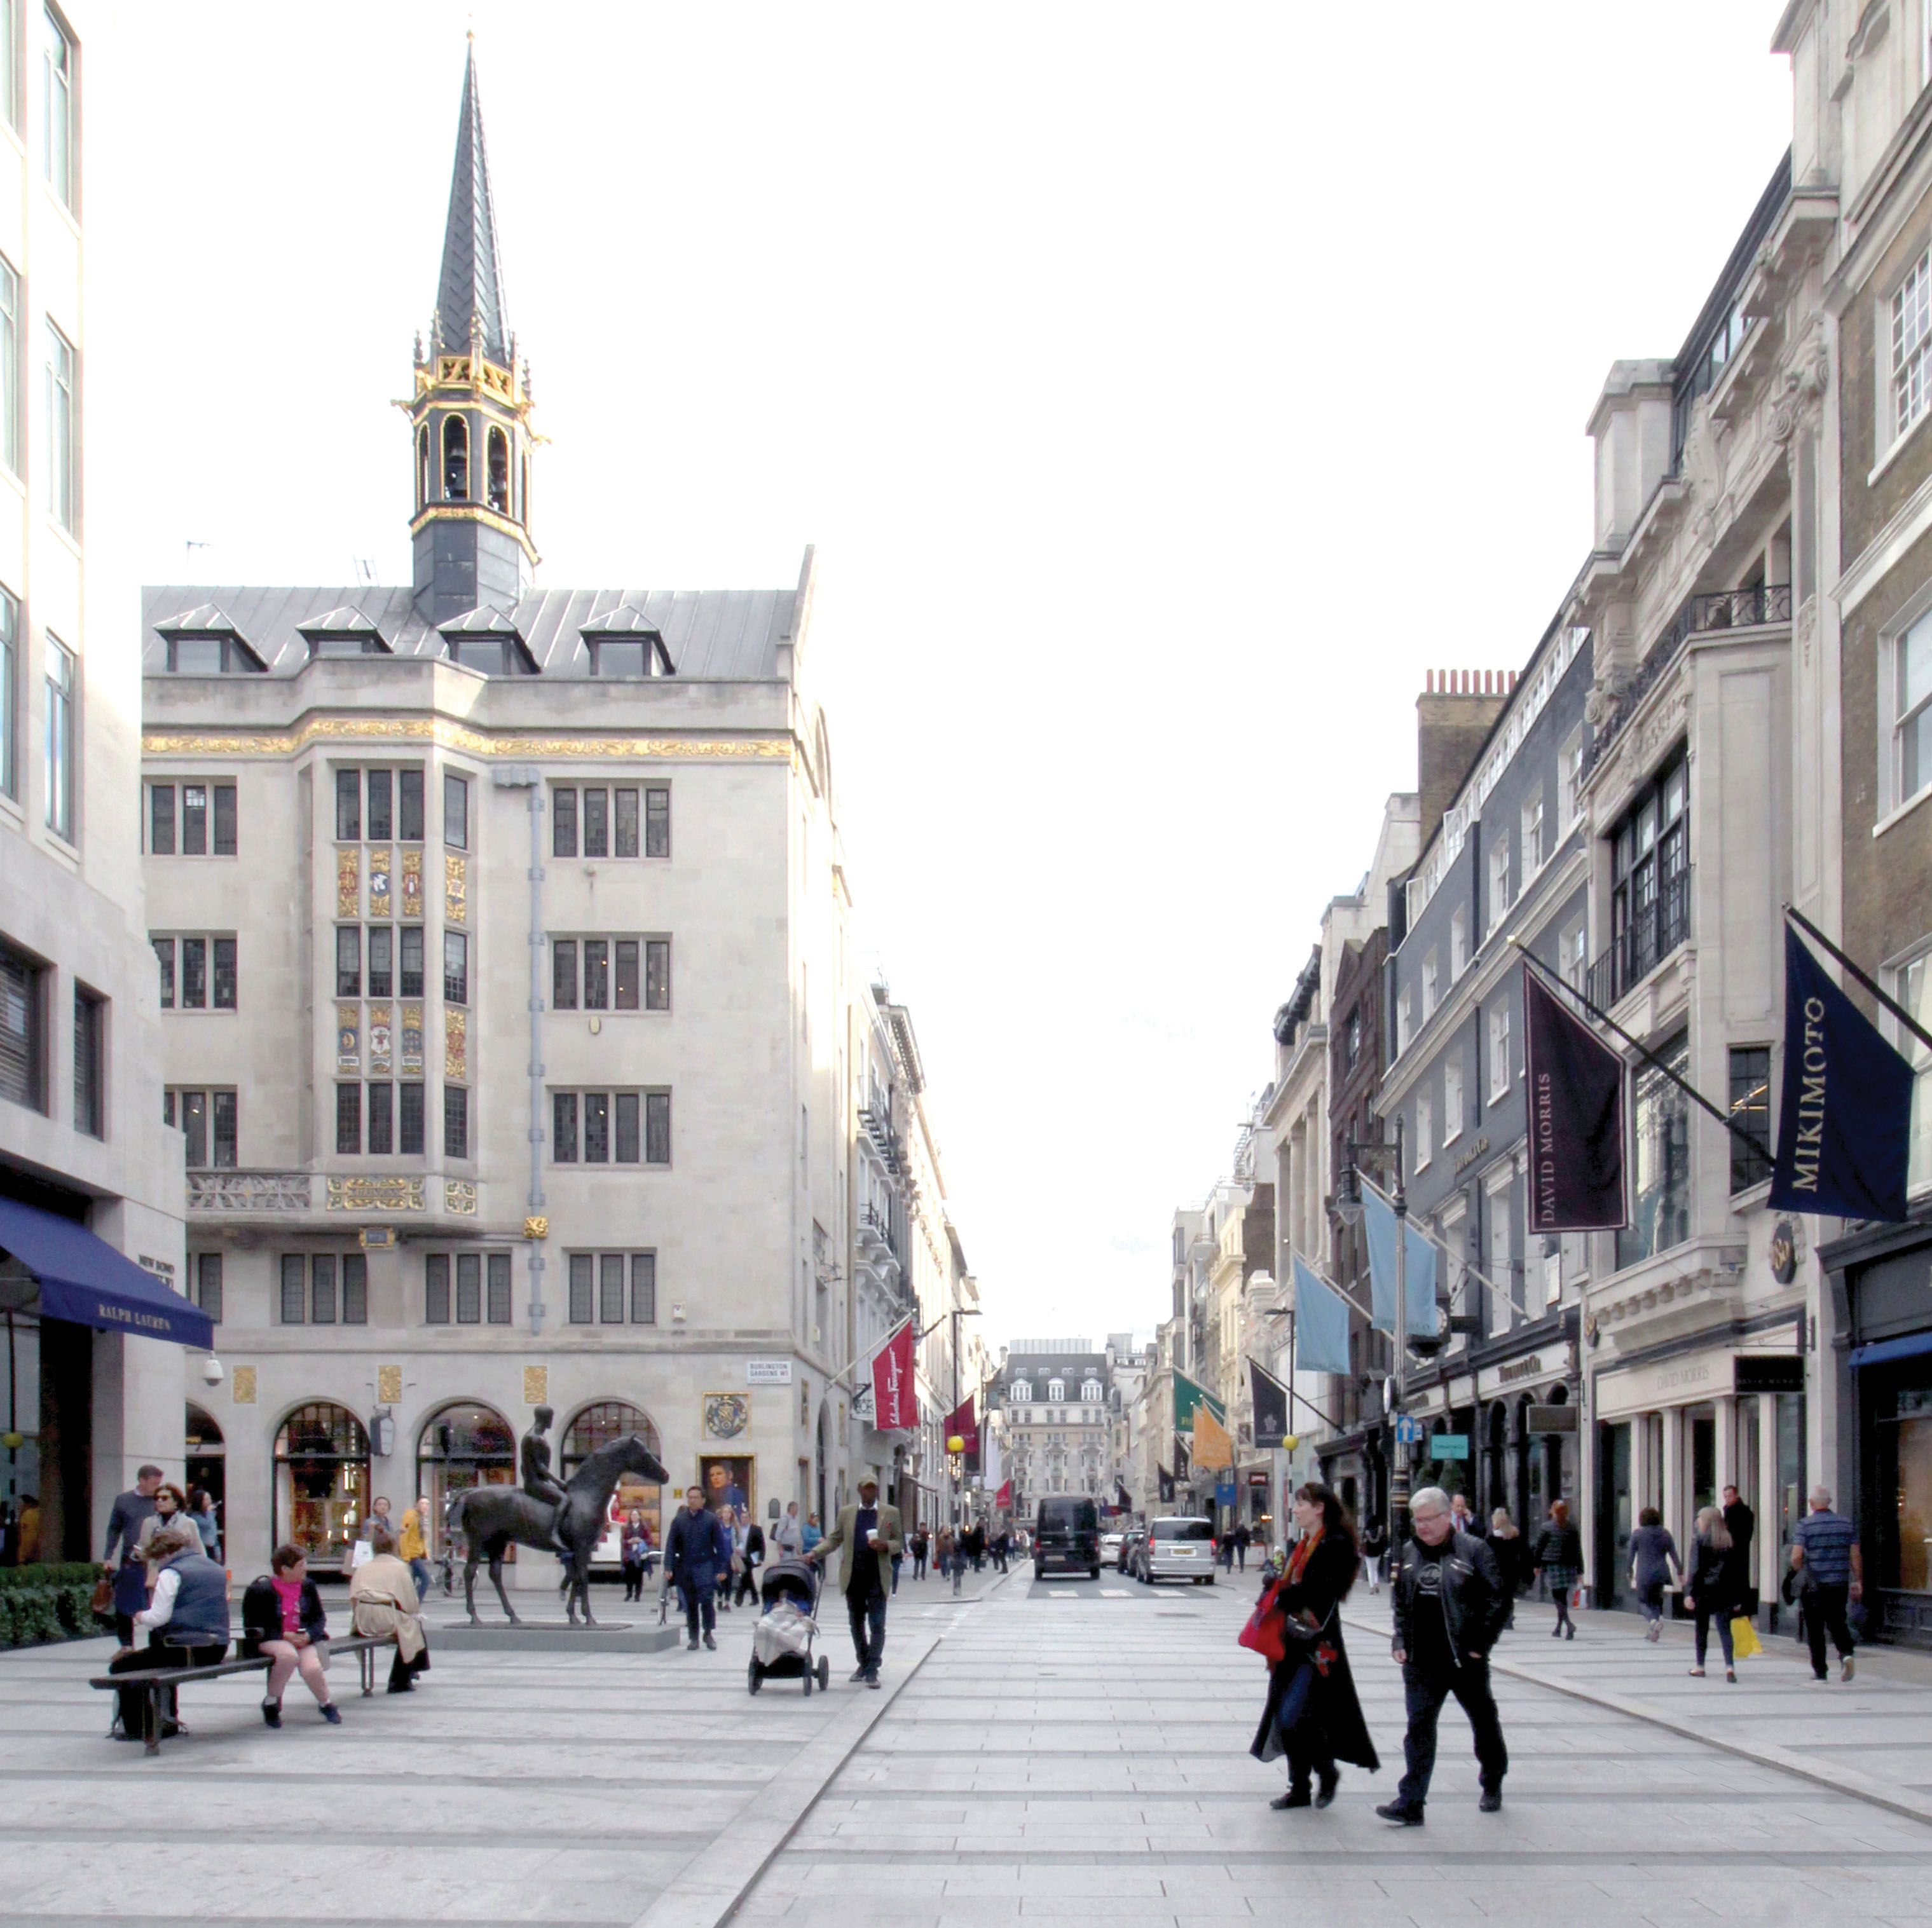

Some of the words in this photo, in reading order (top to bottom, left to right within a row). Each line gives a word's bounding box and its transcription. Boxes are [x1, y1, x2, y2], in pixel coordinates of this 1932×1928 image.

[1538, 1072, 1554, 1153] MORRIS
[1792, 997, 1827, 1193] MIKIMOTO
[1540, 1160, 1555, 1223] DAVID
[138, 1254, 154, 1268] NEW
[99, 1304, 132, 1323] RALPH
[134, 1312, 171, 1330] LAUREN
[1657, 1371, 1679, 1390] DAVID
[1680, 1366, 1710, 1385] MORRIS
